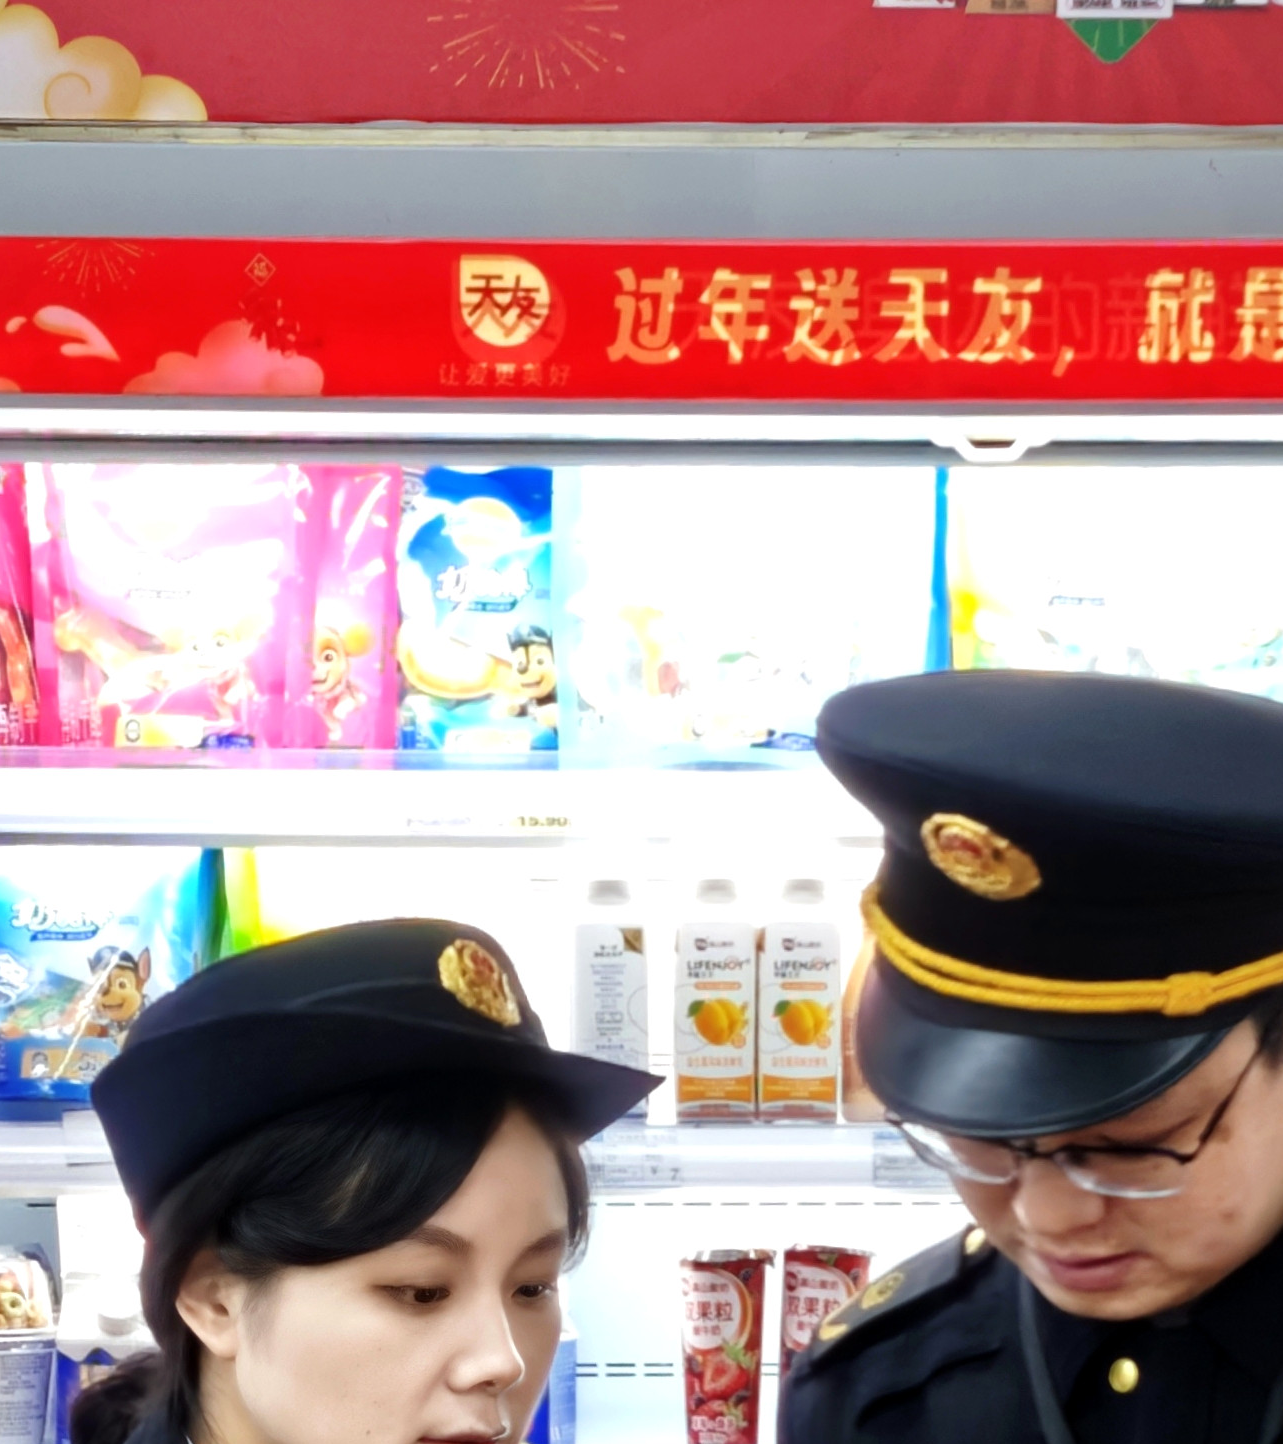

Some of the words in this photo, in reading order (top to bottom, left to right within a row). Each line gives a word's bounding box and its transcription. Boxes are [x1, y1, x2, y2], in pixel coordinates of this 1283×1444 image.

[464, 273, 543, 322] 天友
[439, 363, 571, 388] 让爱更美好
